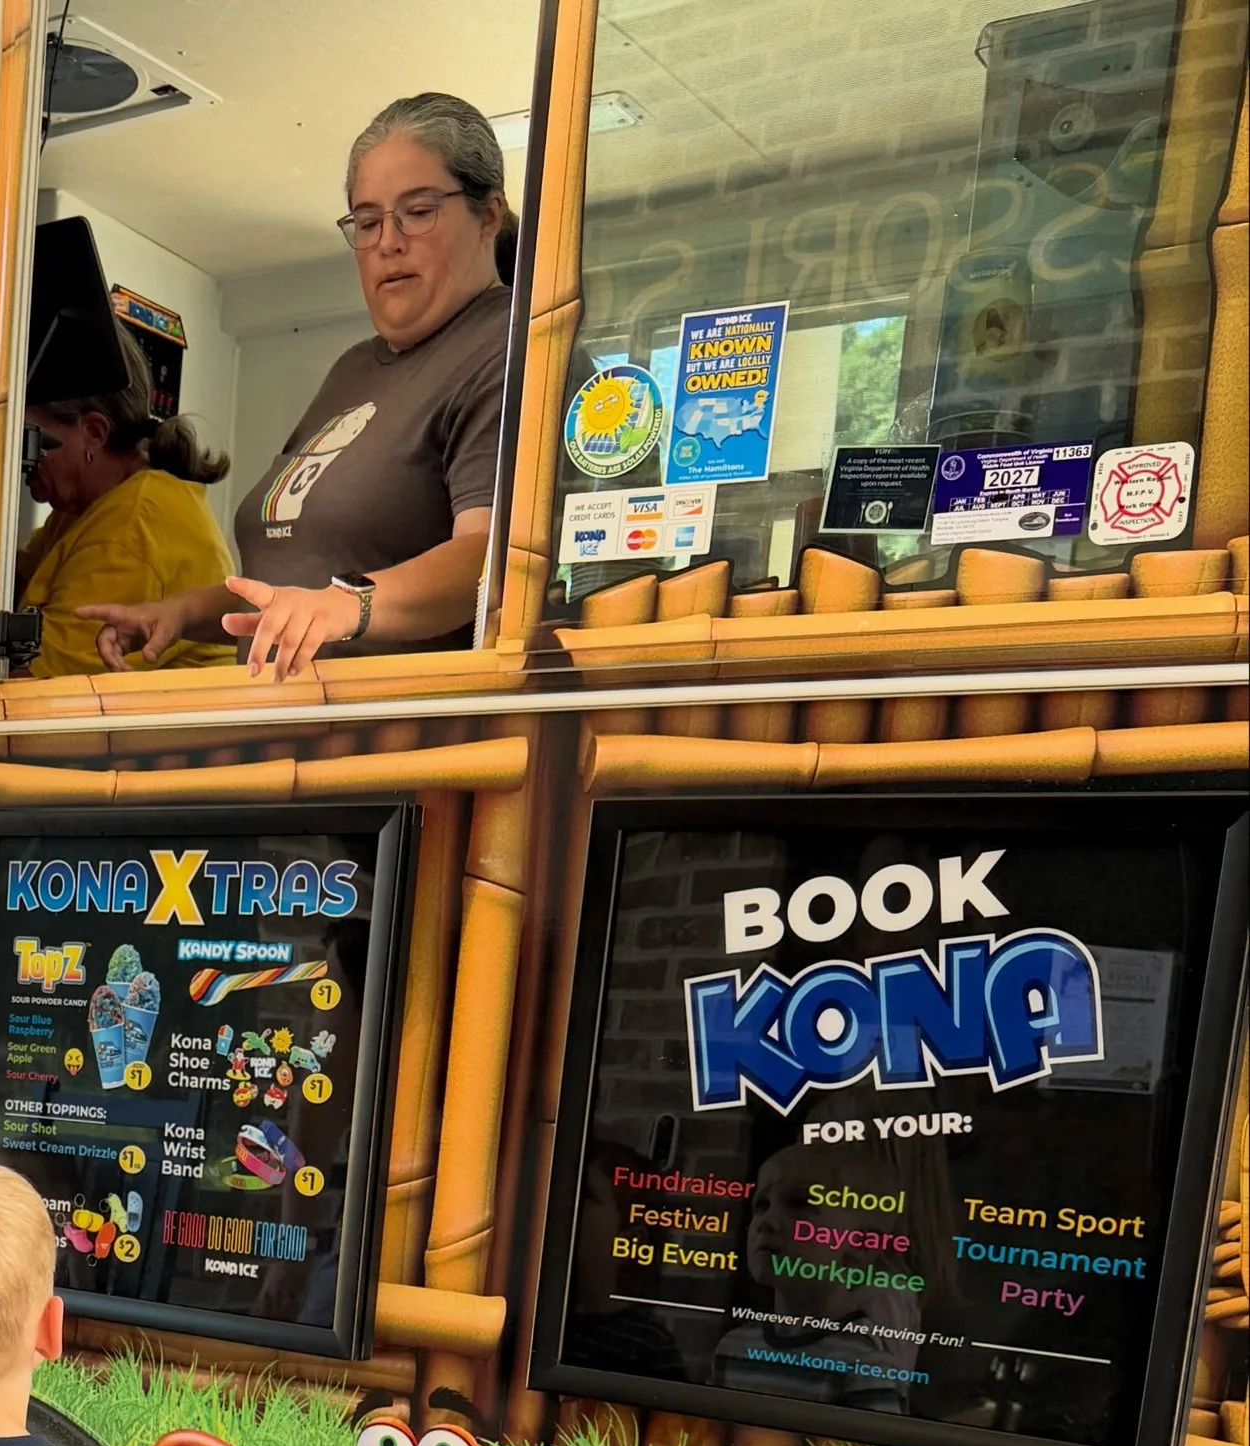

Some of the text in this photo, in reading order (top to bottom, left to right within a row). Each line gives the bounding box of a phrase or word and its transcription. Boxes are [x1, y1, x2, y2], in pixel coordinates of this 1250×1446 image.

[691, 321, 775, 340] WE ARE NATIONALLY
[688, 333, 773, 361] KNOWN
[686, 354, 772, 373] BUT WE ARE LOCALLY
[685, 367, 769, 393] OWNED!
[622, 449, 646, 472] SOLAR
[1055, 446, 1090, 459] 11363
[840, 465, 863, 473] Virginia
[863, 465, 901, 473] Department
[1127, 461, 1162, 470] APPROVED
[988, 468, 1035, 488] 2027
[569, 511, 616, 521] CREDIT CARDS
[633, 503, 658, 514] VISA
[1118, 517, 1156, 525] INSPECTION
[574, 529, 606, 543] KONA
[579, 542, 599, 556] ICE
[722, 848, 1011, 955] BOOK
[178, 940, 291, 962] KANDY SPOON
[13, 937, 86, 993] TopZ
[11, 995, 88, 1008] SOUR POWDER CANDY
[317, 984, 332, 1004] $1
[8, 1013, 53, 1025] Sour Blue
[683, 926, 1106, 1118] KONA
[8, 1025, 54, 1039] Raspberry
[170, 1032, 212, 1051] Kona
[6, 1052, 33, 1064] Apple
[7, 1041, 57, 1055] Sour Green
[168, 1052, 210, 1070] Shoe
[250, 1056, 276, 1068] KONA
[5, 1070, 59, 1084] Sour Cherry
[130, 1069, 143, 1088] $1
[167, 1071, 232, 1091] Charms
[309, 1079, 325, 1099] $1
[4, 1099, 108, 1119] OTHER TOPPINGS:
[3, 1119, 57, 1136] Sour Shot
[163, 1122, 206, 1141] Kona
[802, 1111, 973, 1146] FOR YOUR:
[2, 1136, 118, 1160] Sweet Cream Drizzle
[162, 1141, 206, 1160] Wrist
[161, 1160, 204, 1179] Band
[301, 1171, 316, 1191] $1
[613, 1165, 757, 1199] Fundraiser
[42, 1199, 72, 1212] oam
[807, 1183, 906, 1214] School
[629, 1203, 730, 1233] Festival
[963, 1198, 1146, 1239] Team Sport
[162, 1210, 308, 1262] BE GOOD DO GOOD FOR GOOD
[792, 1219, 911, 1253] Daycare
[118, 1239, 135, 1258] $2
[612, 1236, 739, 1271] Big Event
[951, 1235, 1147, 1280] Tournament
[204, 1257, 260, 1279] KONA ICE
[771, 1254, 926, 1293] Workplace
[1000, 1280, 1086, 1317] Party
[731, 1306, 965, 1349] Wherever Folks Are Having Fun!
[745, 1347, 931, 1385] www.kona-ice.com
